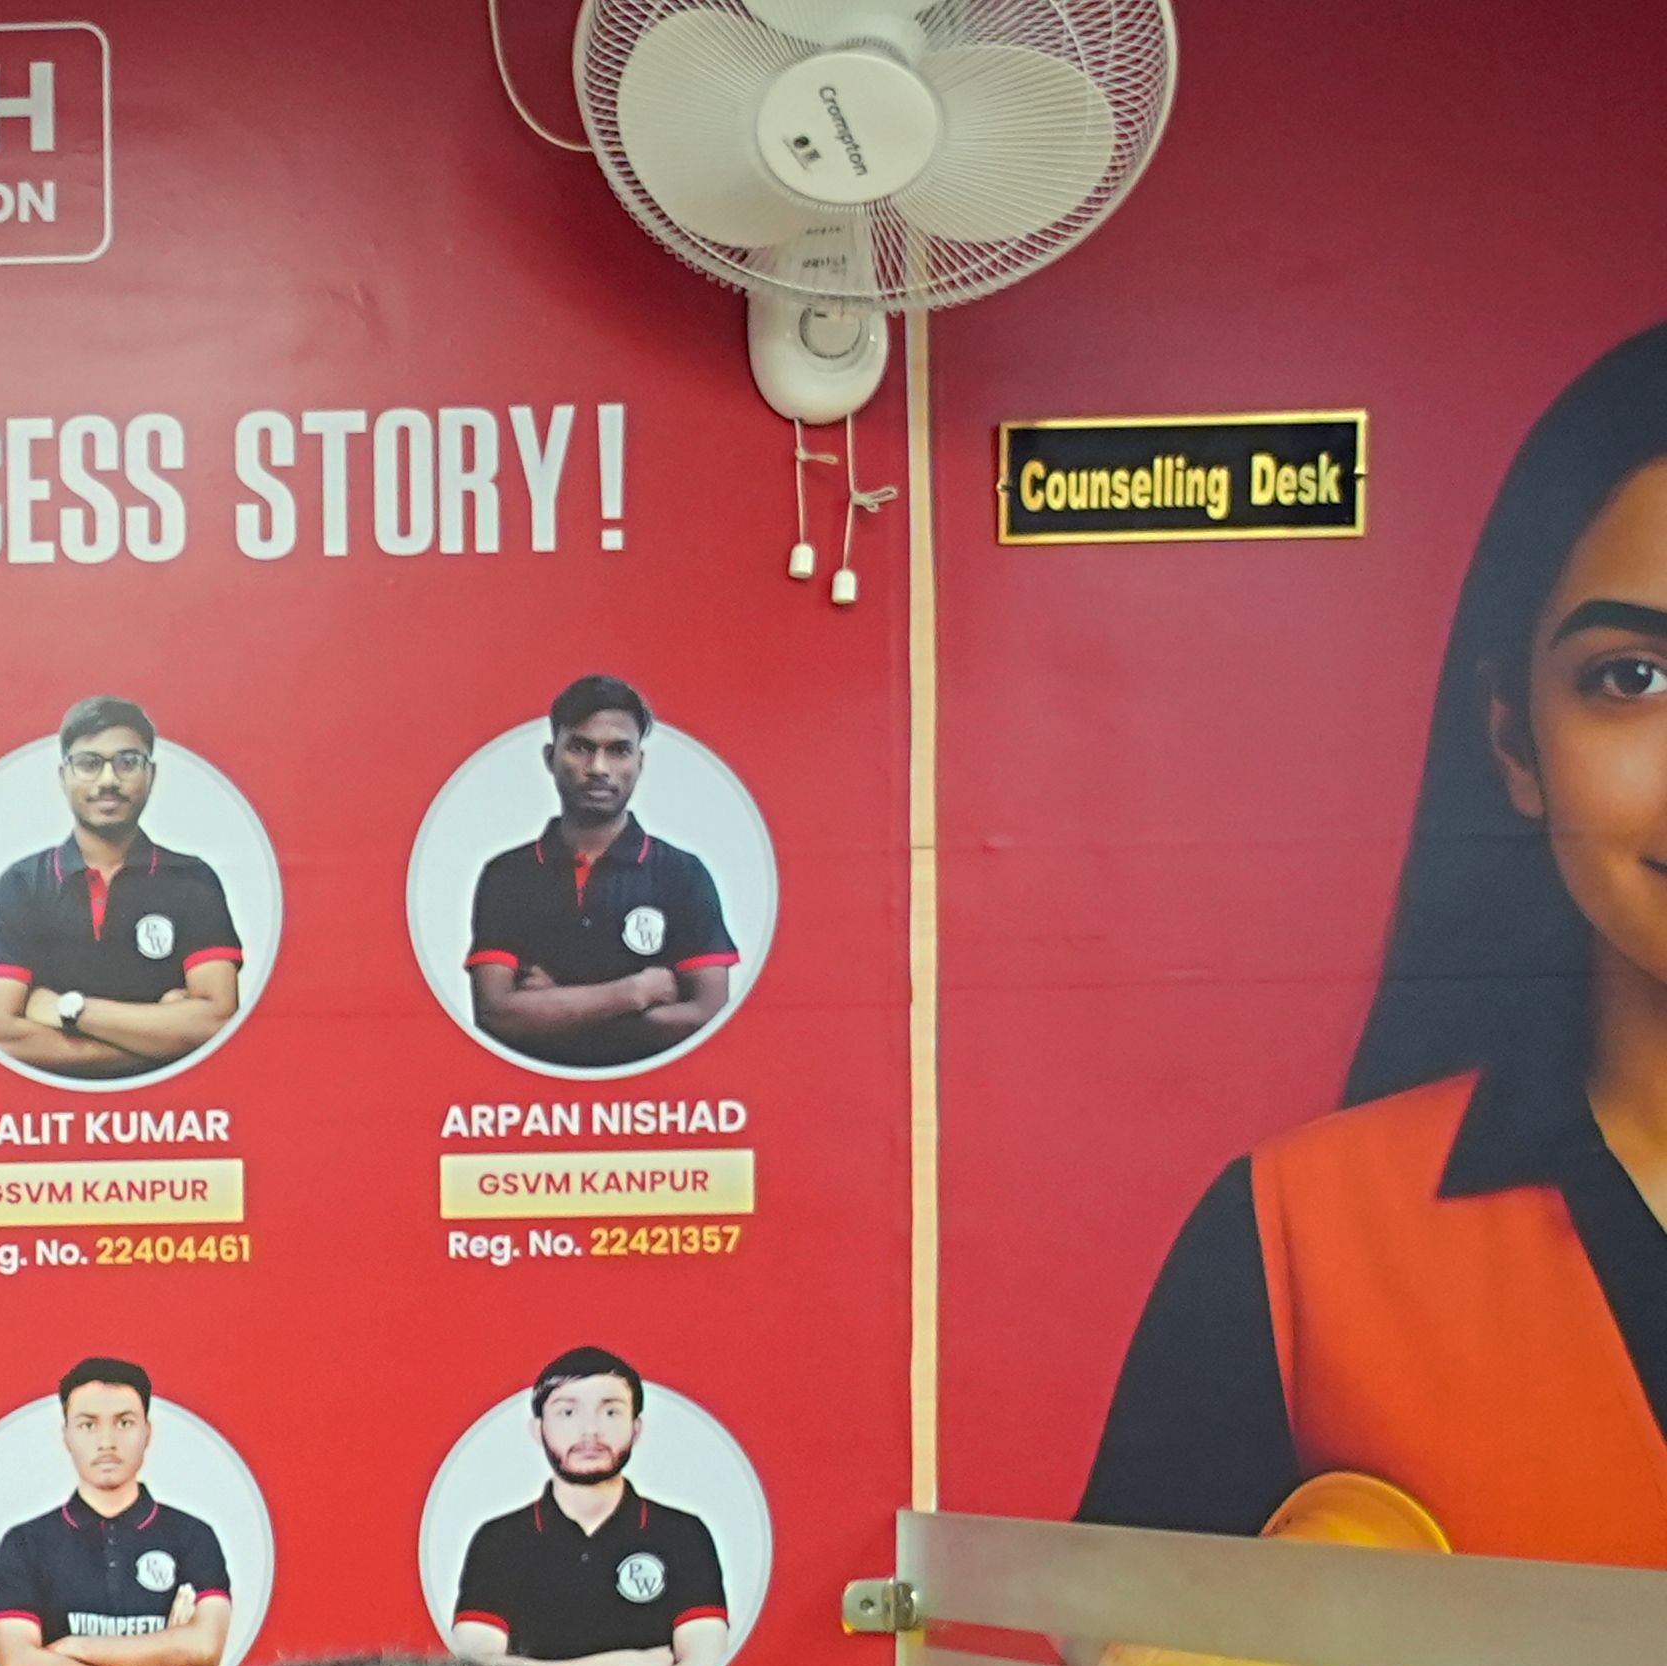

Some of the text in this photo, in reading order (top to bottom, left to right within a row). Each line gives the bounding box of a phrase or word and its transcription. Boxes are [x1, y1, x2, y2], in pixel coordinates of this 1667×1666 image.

[820, 86, 868, 176] Crompton
[235, 404, 623, 560] STORY!
[1020, 453, 1341, 520] Counselling Desk
[86, 1110, 229, 1143] KUMAR
[442, 1100, 746, 1137] ARPAN NISHAD
[83, 1180, 207, 1202] KANPUR
[479, 1170, 708, 1195] GSVM KANPUR
[36, 1240, 88, 1265] No.
[96, 1235, 249, 1264] 22404461
[449, 1225, 740, 1266] Reg. No. 22421357
